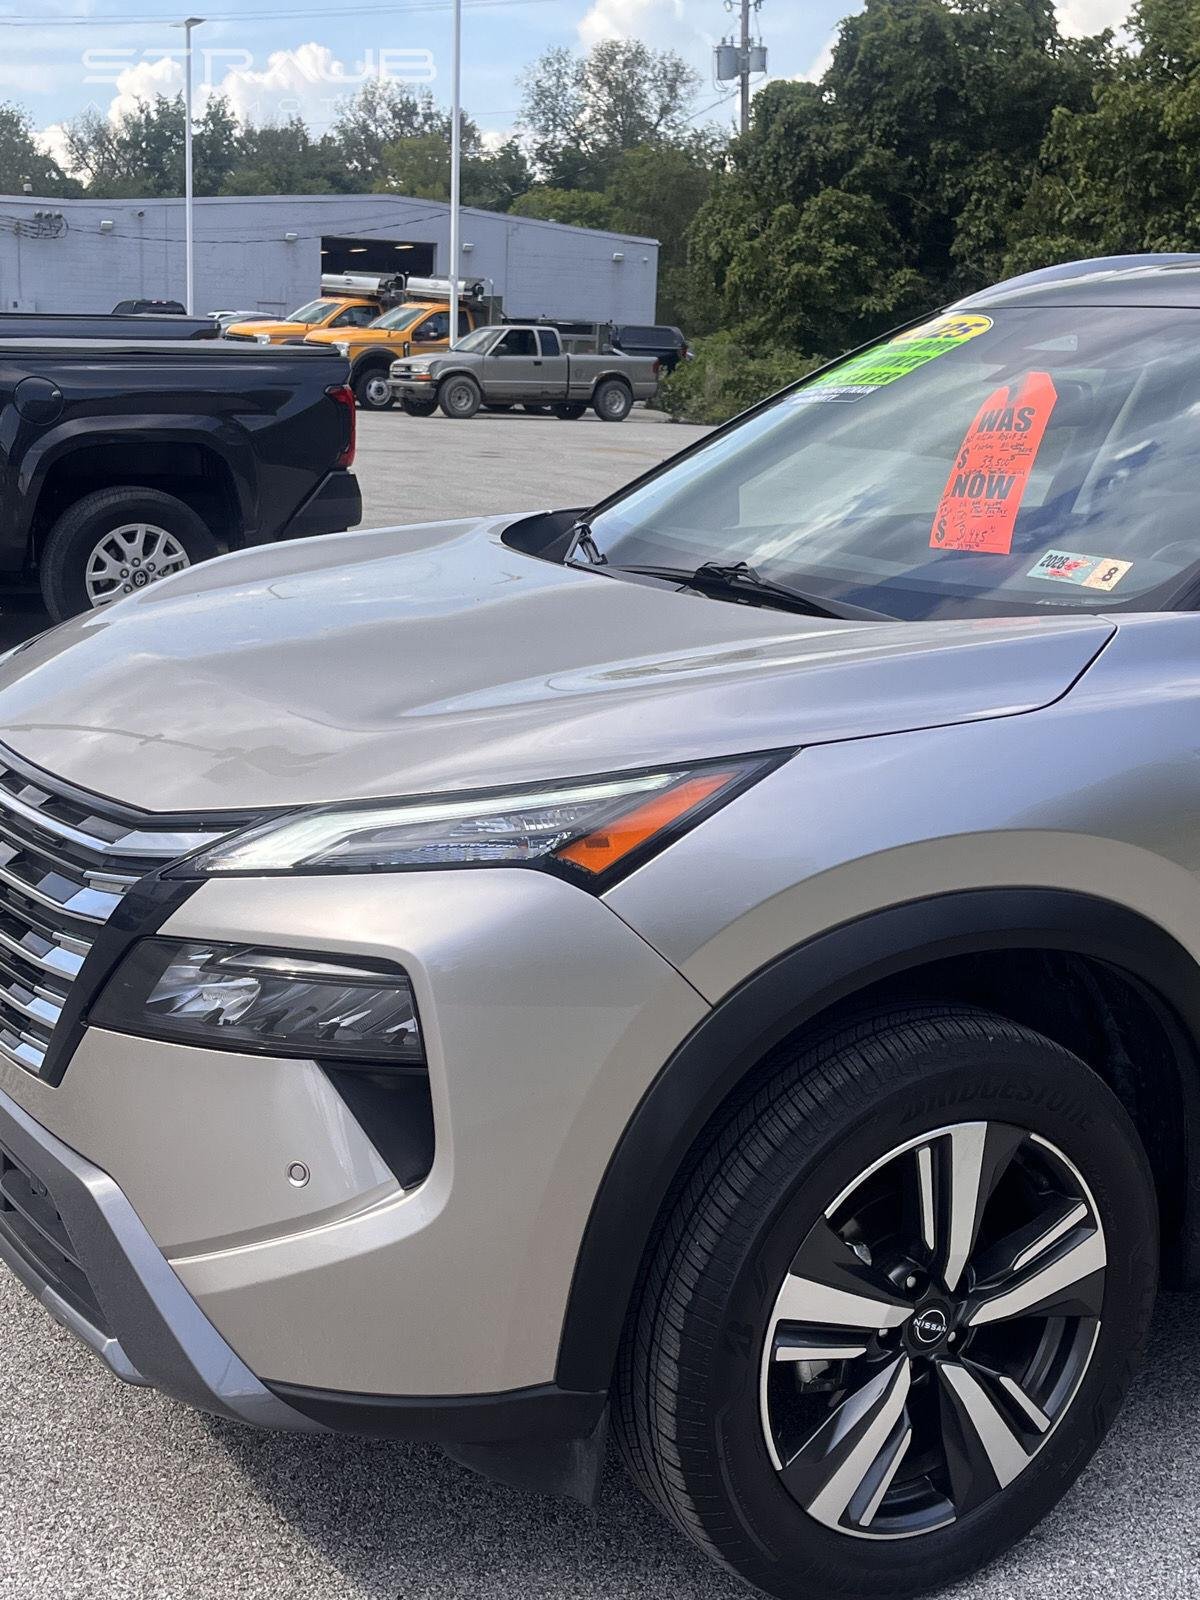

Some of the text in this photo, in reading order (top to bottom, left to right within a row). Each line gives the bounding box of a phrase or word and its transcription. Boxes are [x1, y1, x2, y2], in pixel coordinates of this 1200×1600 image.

[977, 406, 1036, 433] WAS
[956, 446, 970, 470] $
[951, 473, 1016, 500] NOW
[934, 517, 948, 544] $
[1101, 566, 1119, 582] 8
[913, 1317, 948, 1334] NISSAN
